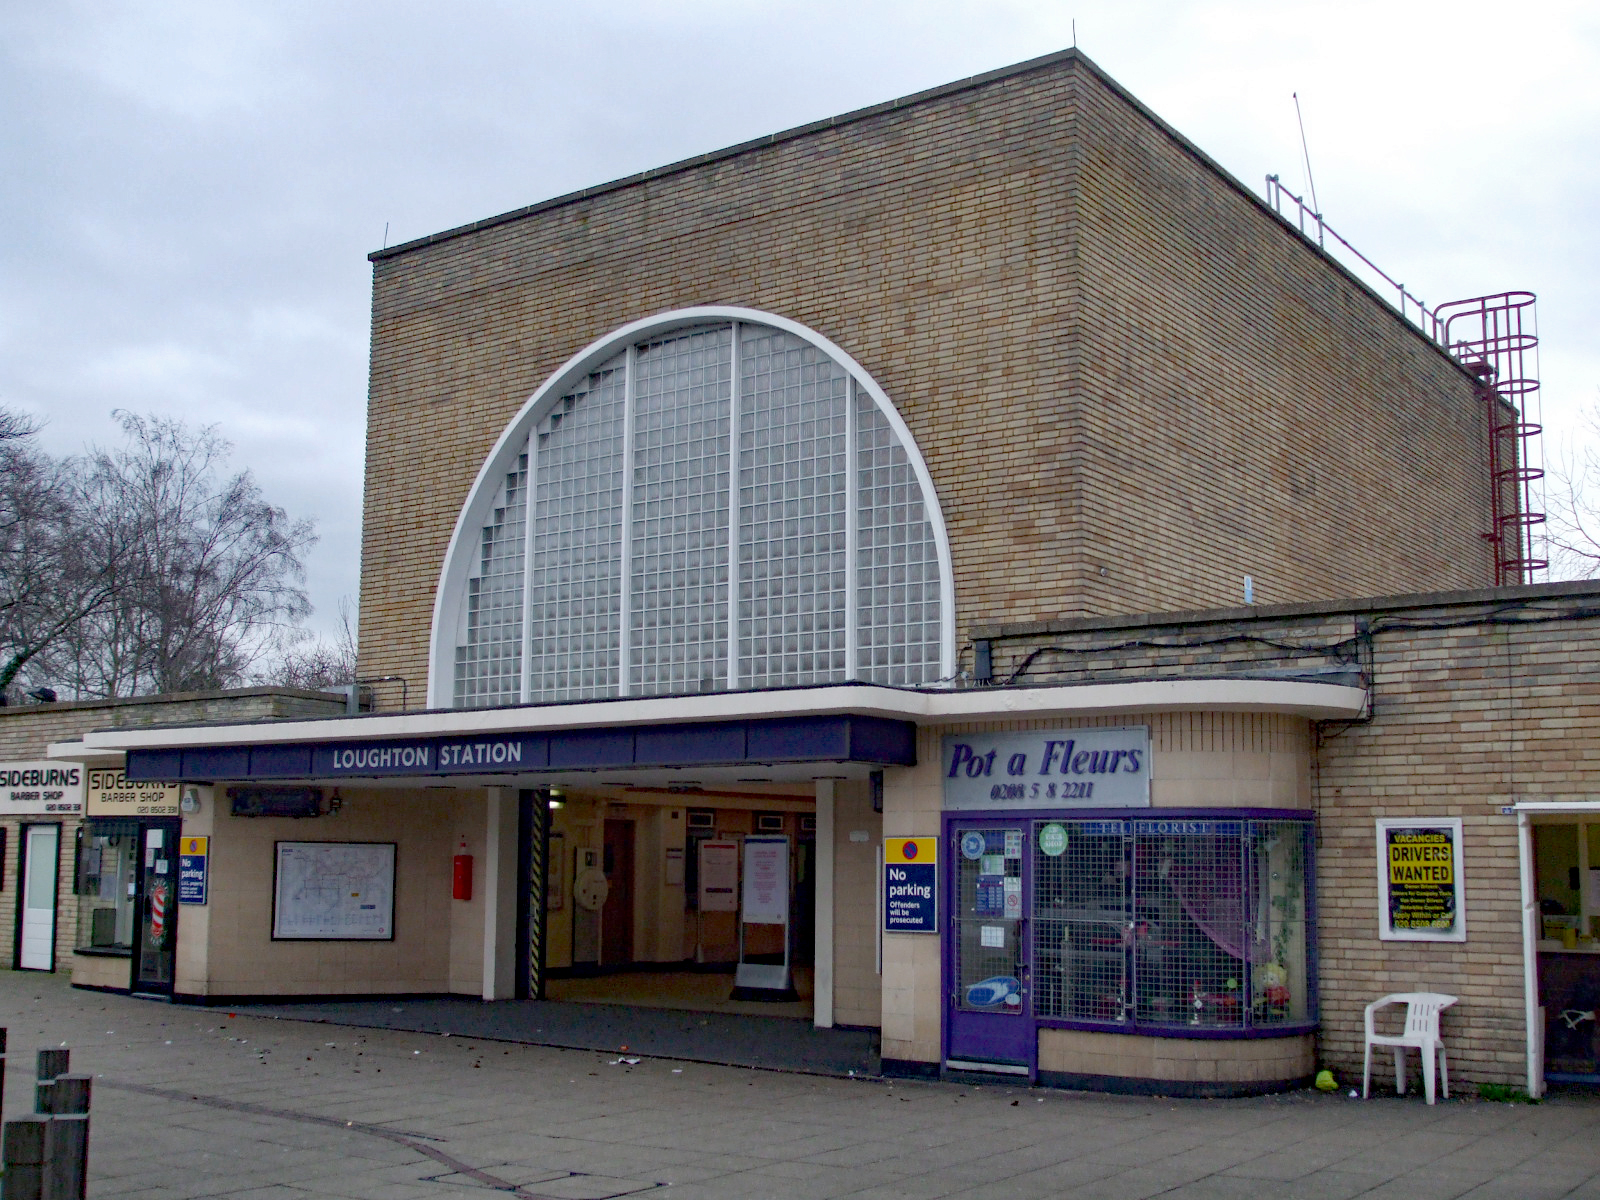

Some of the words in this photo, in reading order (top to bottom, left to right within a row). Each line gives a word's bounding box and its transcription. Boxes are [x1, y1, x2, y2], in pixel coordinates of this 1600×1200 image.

[333, 747, 429, 769] LOUGHTON
[440, 742, 522, 765] STATION
[948, 743, 997, 778] Pot
[1007, 752, 1027, 776] a
[1039, 739, 1143, 776] Fleurs
[0, 768, 79, 787] SIDEBURNS
[10, 791, 40, 800] BARBER
[43, 791, 64, 800] SHOP
[1029, 783, 1040, 799] 5
[1061, 782, 1094, 799] 2211
[101, 792, 136, 802] BARBER
[139, 792, 165, 802] SHOP
[137, 806, 149, 814] 020
[1394, 834, 1445, 843] VACANCIES
[1392, 846, 1449, 862] DRIVERS
[182, 859, 192, 867] No
[182, 869, 203, 880] parking
[889, 868, 907, 881] No
[1393, 866, 1449, 881] WANTED
[889, 883, 931, 899] parking
[889, 901, 920, 909] Offenders
[889, 916, 923, 925] prosecuted
